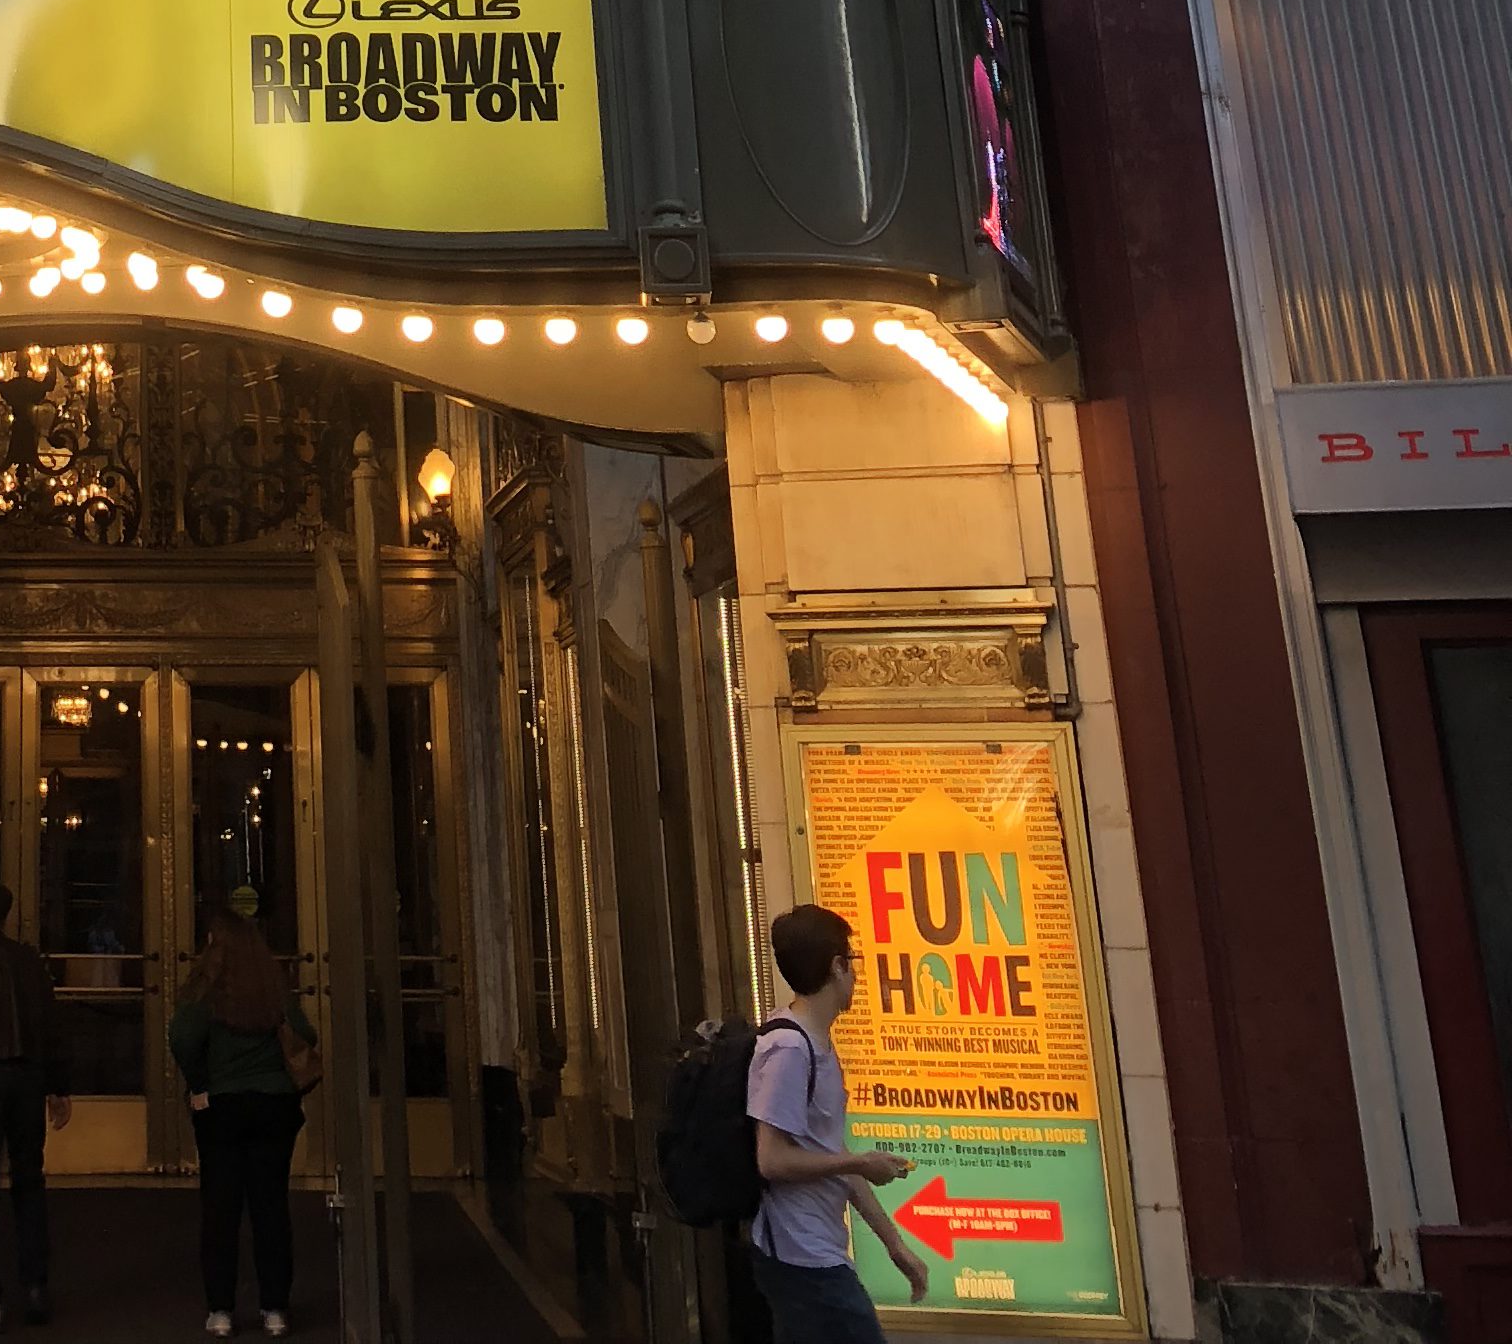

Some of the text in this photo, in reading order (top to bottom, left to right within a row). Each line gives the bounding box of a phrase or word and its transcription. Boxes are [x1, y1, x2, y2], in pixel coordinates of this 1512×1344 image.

[251, 31, 561, 90] BROADWAY
[253, 83, 560, 124] IN BOSTON
[866, 851, 1027, 946] FUN
[877, 952, 1037, 1017] HOME
[880, 1025, 1039, 1038] A TRUE STORY BECOMES A
[963, 1038, 989, 1053] BEST
[993, 1039, 1041, 1055] MUSICAL
[851, 1122, 1087, 1144] OCTOBER 17-29 BOSTON OPERA HOUSE
[955, 1143, 1066, 1157] BroadwayInBoston.com
[913, 1205, 954, 1217] PURCHASE
[955, 1207, 974, 1218] NOW
[976, 1208, 985, 1218] AT
[987, 1208, 1002, 1218] THE
[1004, 1209, 1020, 1219] BOX
